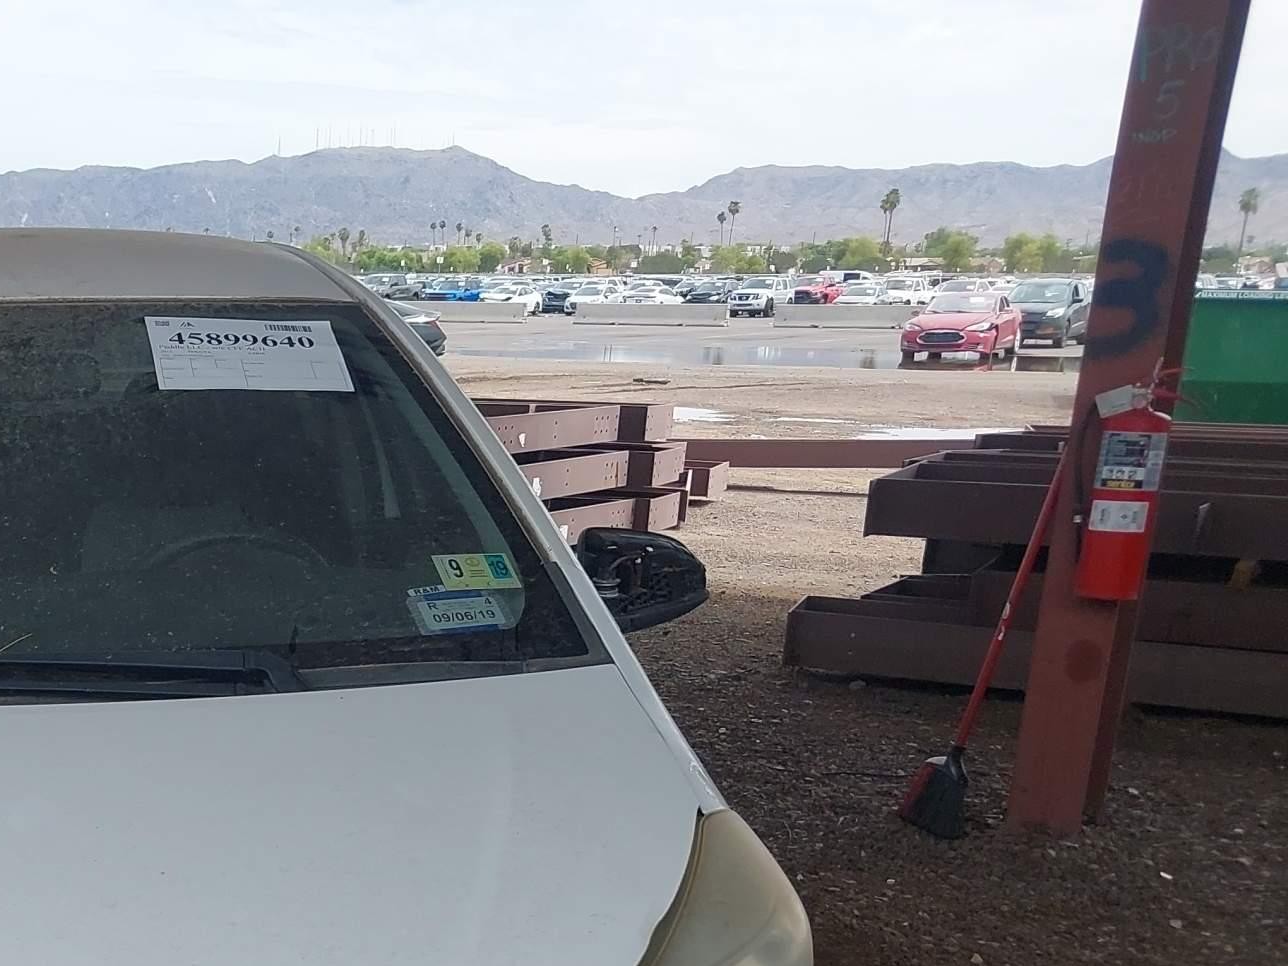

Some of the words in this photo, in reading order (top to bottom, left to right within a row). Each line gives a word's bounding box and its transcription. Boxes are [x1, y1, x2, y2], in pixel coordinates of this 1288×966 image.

[1085, 237, 1170, 360] 3
[168, 332, 314, 348] 45899640
[448, 558, 464, 578] 9
[427, 602, 438, 610] R
[433, 609, 496, 623] 09/06/19
